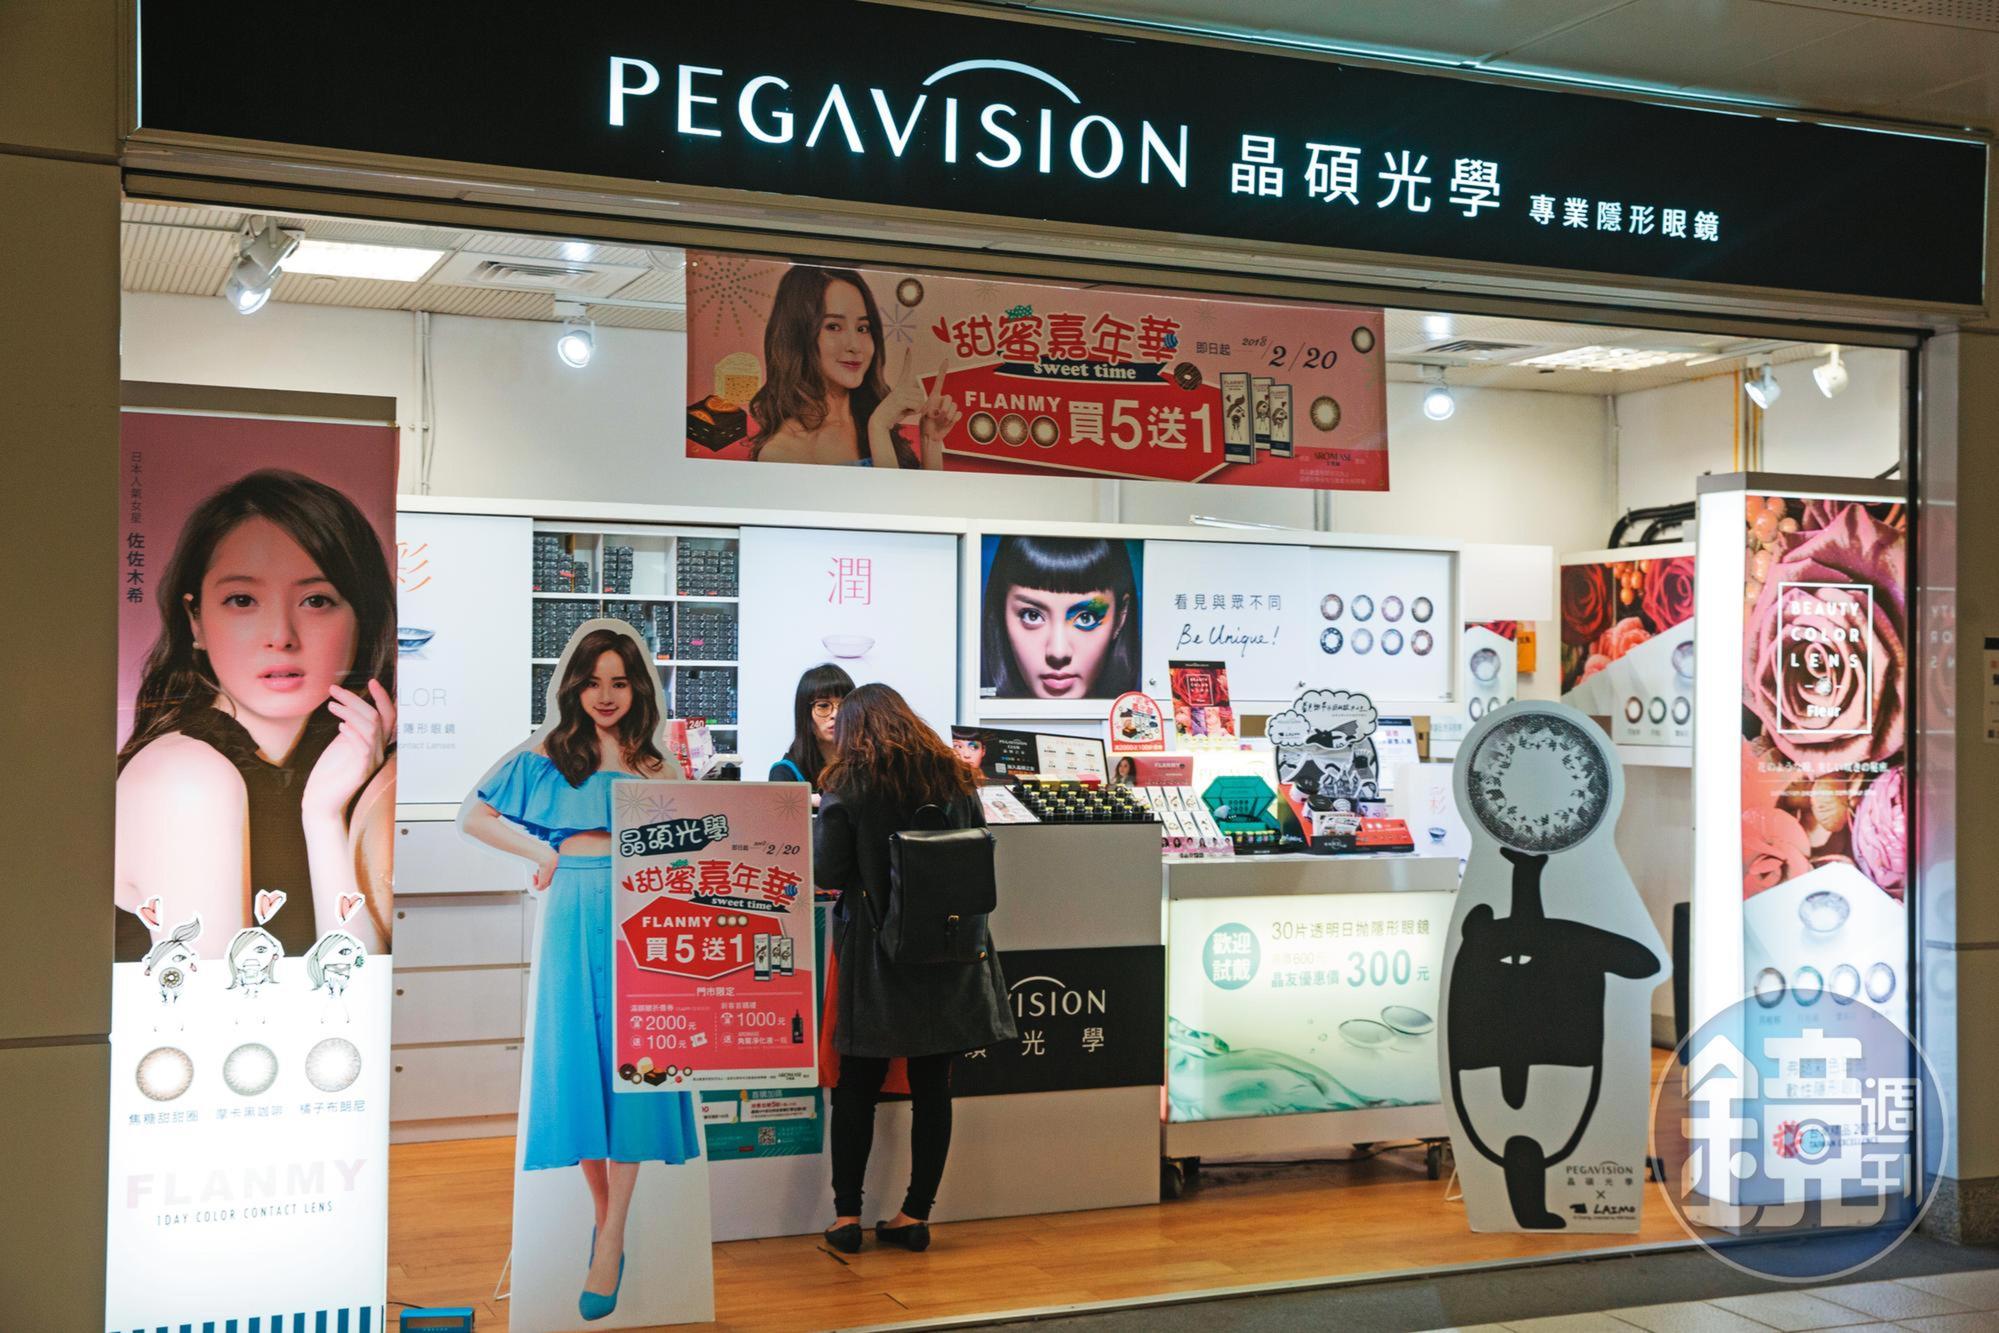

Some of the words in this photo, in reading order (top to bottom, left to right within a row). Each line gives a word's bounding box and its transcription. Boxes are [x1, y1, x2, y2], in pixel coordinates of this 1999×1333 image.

[608, 56, 1189, 188] PEGAVISION
[1231, 134, 1500, 217] 晶碩光學
[1528, 194, 1720, 241] 專業隱形眼鏡
[952, 313, 1182, 363] 甜蜜嘉年華
[1196, 341, 1231, 356] 即日起
[1034, 362, 1089, 378] sweet
[1094, 365, 1137, 380] time
[965, 391, 1061, 412] FLANMY
[1068, 399, 1213, 453] 買5送1
[127, 532, 145, 603] 佐佐木希
[827, 556, 871, 605] 潤
[1790, 601, 1859, 616] BEAUTY
[1177, 623, 1203, 650] Be
[1208, 625, 1280, 658] Unique!
[1790, 627, 1859, 642] COLOR
[1790, 653, 1858, 668] LENS
[1806, 704, 1841, 717] Fleur
[621, 815, 728, 857] 晶碩光學
[635, 860, 801, 905] 甜蜜嘉年華
[712, 897, 744, 908] sweet
[747, 901, 772, 911] time
[642, 917, 712, 928] FLANMY
[646, 934, 744, 963] 買5送1
[1212, 931, 1252, 955] 歡迎
[1212, 960, 1251, 981] 試戴
[1566, 1161, 1634, 1175] PEGAVISION
[126, 1158, 368, 1209] FLANMY
[157, 1214, 188, 1226] 1DAY
[196, 1208, 236, 1223] COLOR
[243, 1203, 297, 1219] CONTACT
[304, 1200, 333, 1213] LENS
